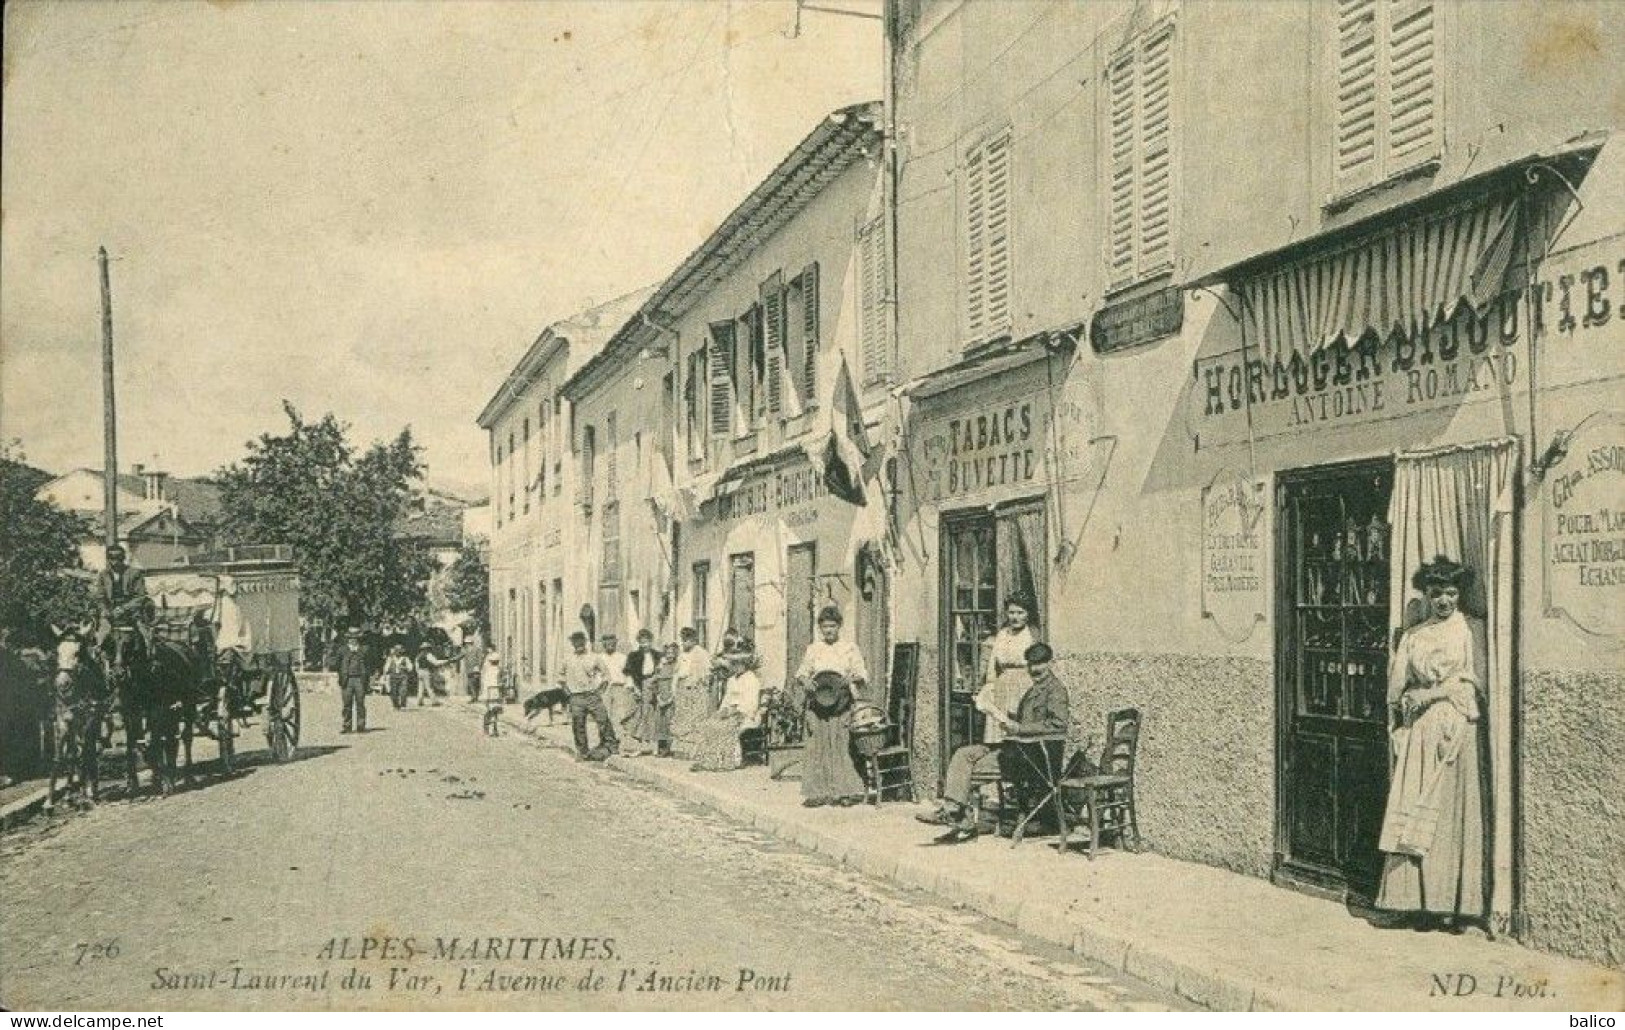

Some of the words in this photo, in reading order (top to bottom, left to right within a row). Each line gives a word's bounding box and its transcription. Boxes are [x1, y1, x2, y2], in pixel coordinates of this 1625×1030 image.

[1392, 258, 1625, 374] BIJOUTIE
[1290, 380, 1385, 427] ANTOINE
[1406, 351, 1518, 404] ROMANO
[950, 404, 1031, 456] TABACS
[950, 449, 1034, 493] BUVETTE
